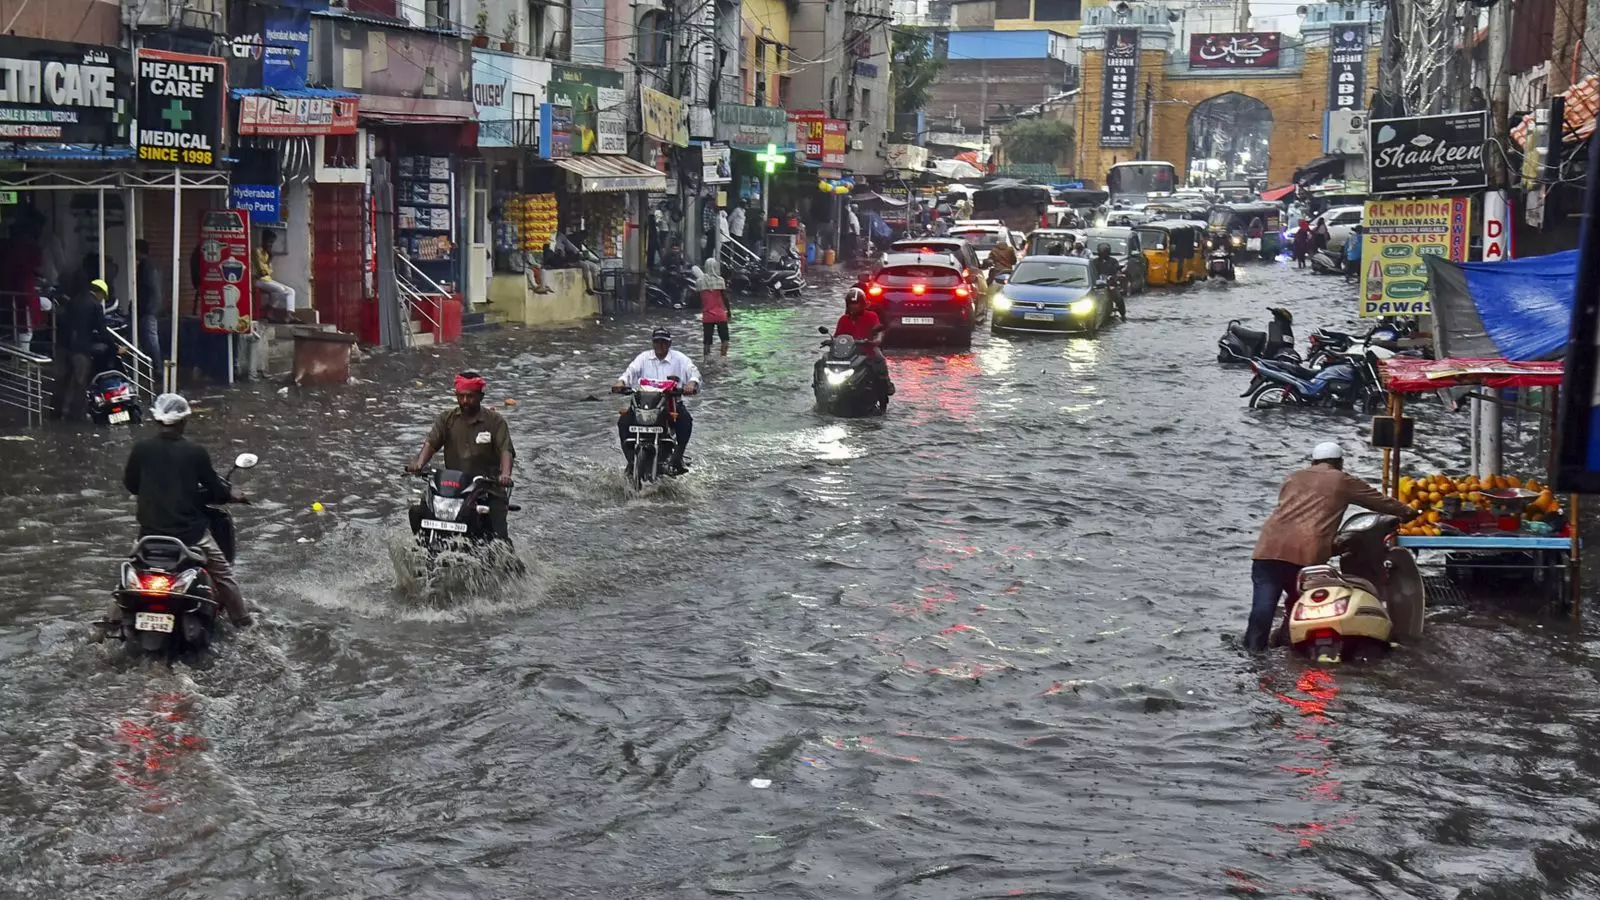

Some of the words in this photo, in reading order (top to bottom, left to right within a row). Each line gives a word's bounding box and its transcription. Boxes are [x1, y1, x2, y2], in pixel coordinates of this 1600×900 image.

[141, 62, 214, 83] HEALTH
[45, 61, 115, 108] CARE
[150, 79, 204, 98] CARE
[140, 129, 212, 150] MEDICAL
[139, 147, 179, 162] SINCE
[182, 150, 213, 165] 1998
[1375, 139, 1481, 168] Shaukeen
[234, 186, 275, 202] Hyderabad
[236, 202, 253, 212] Auto
[254, 203, 275, 213] Parts
[1369, 202, 1450, 218] AL-MADINA
[1369, 219, 1399, 227] UNANI
[1402, 217, 1448, 226] DAWASAZ
[1369, 234, 1447, 244] STOCKIST
